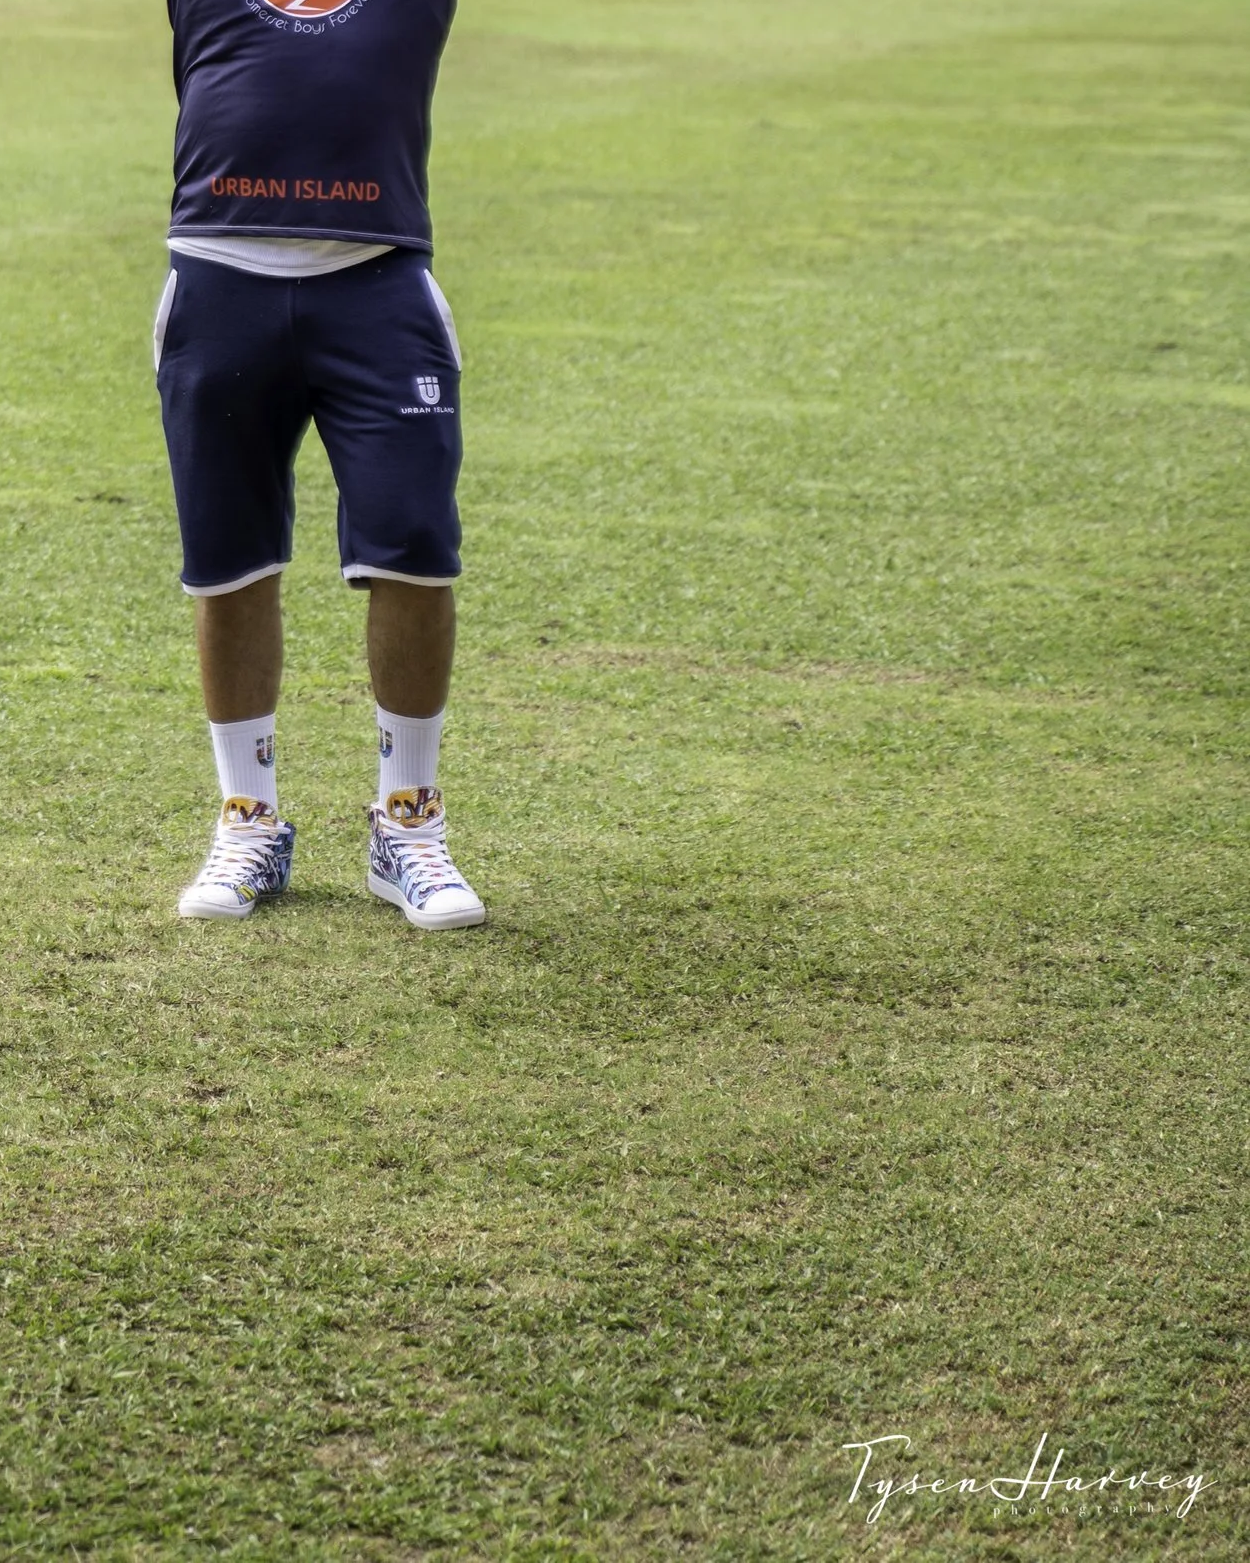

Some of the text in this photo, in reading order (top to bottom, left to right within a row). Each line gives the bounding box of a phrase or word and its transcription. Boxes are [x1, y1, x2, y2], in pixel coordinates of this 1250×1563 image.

[294, 20, 326, 35] Boys
[210, 175, 381, 202] URBAN ISLAND
[433, 406, 455, 414] ISLAND
